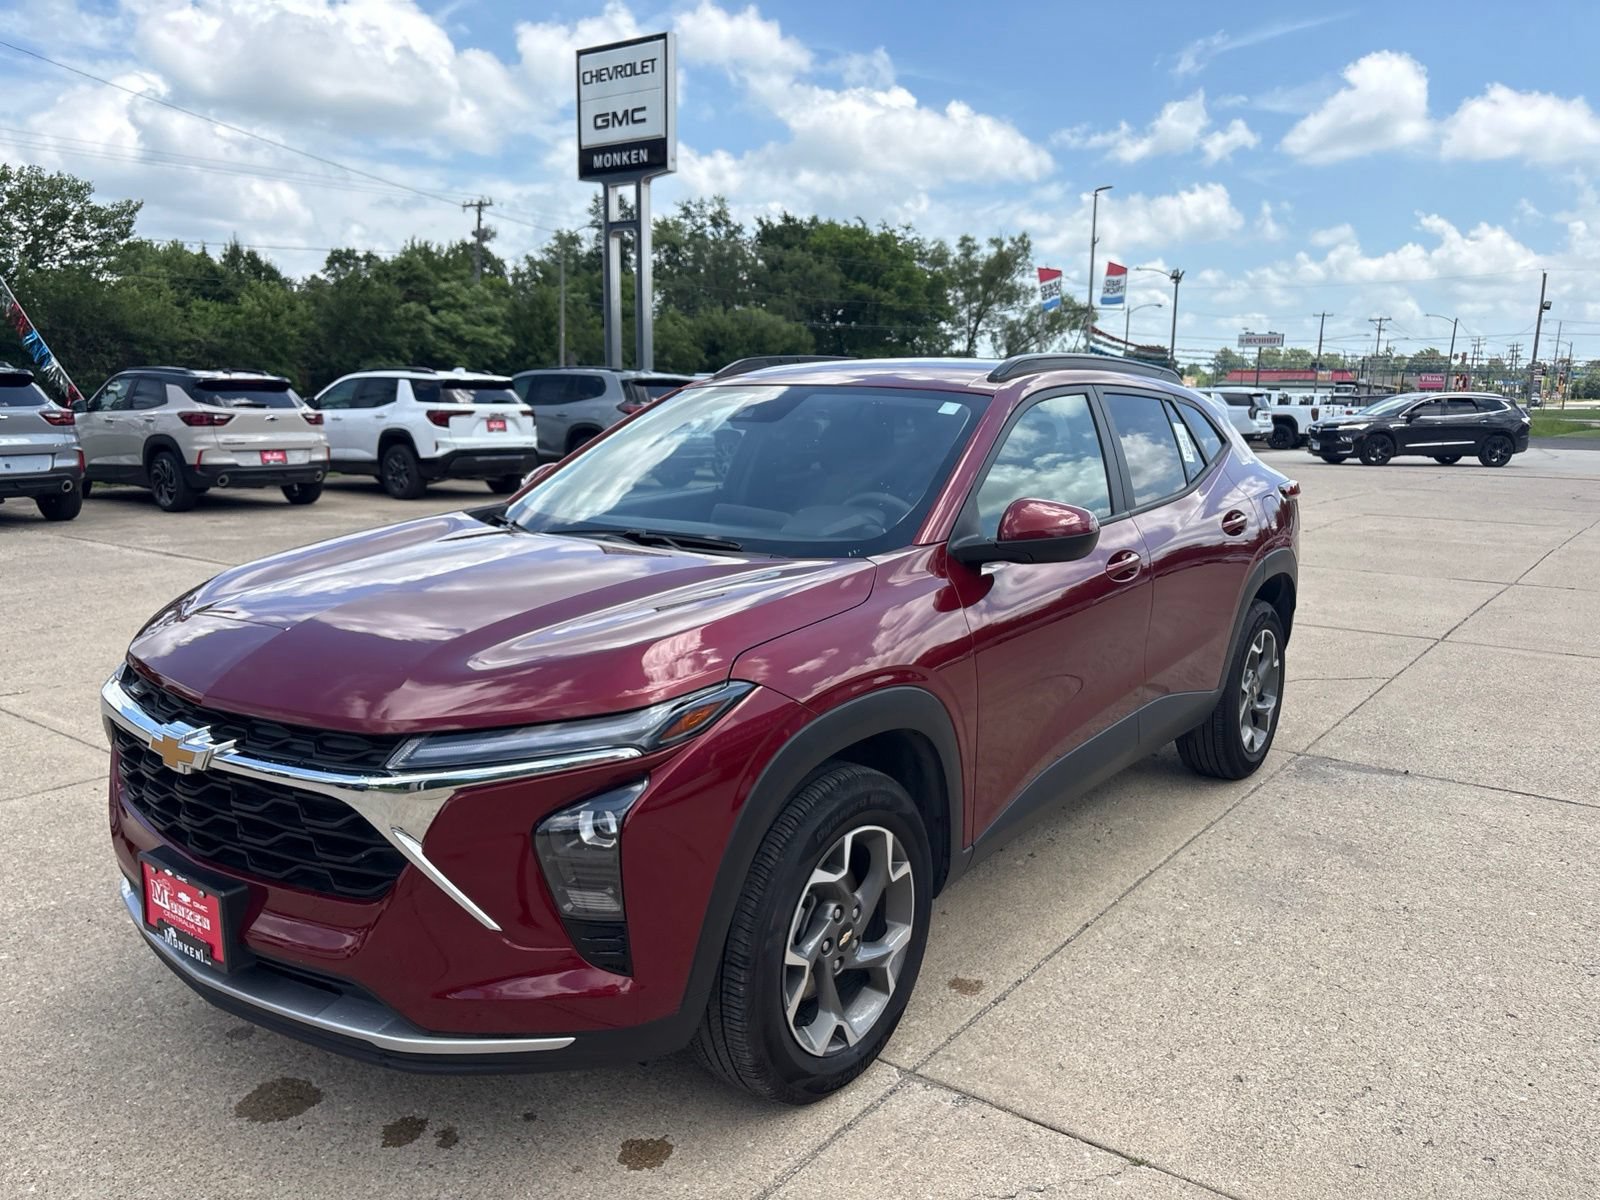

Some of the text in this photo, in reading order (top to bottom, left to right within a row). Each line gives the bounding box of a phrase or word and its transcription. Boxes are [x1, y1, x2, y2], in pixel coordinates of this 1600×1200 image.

[582, 58, 657, 85] CHEVROLET
[593, 106, 647, 131] GMC
[593, 149, 649, 169] MONKEN
